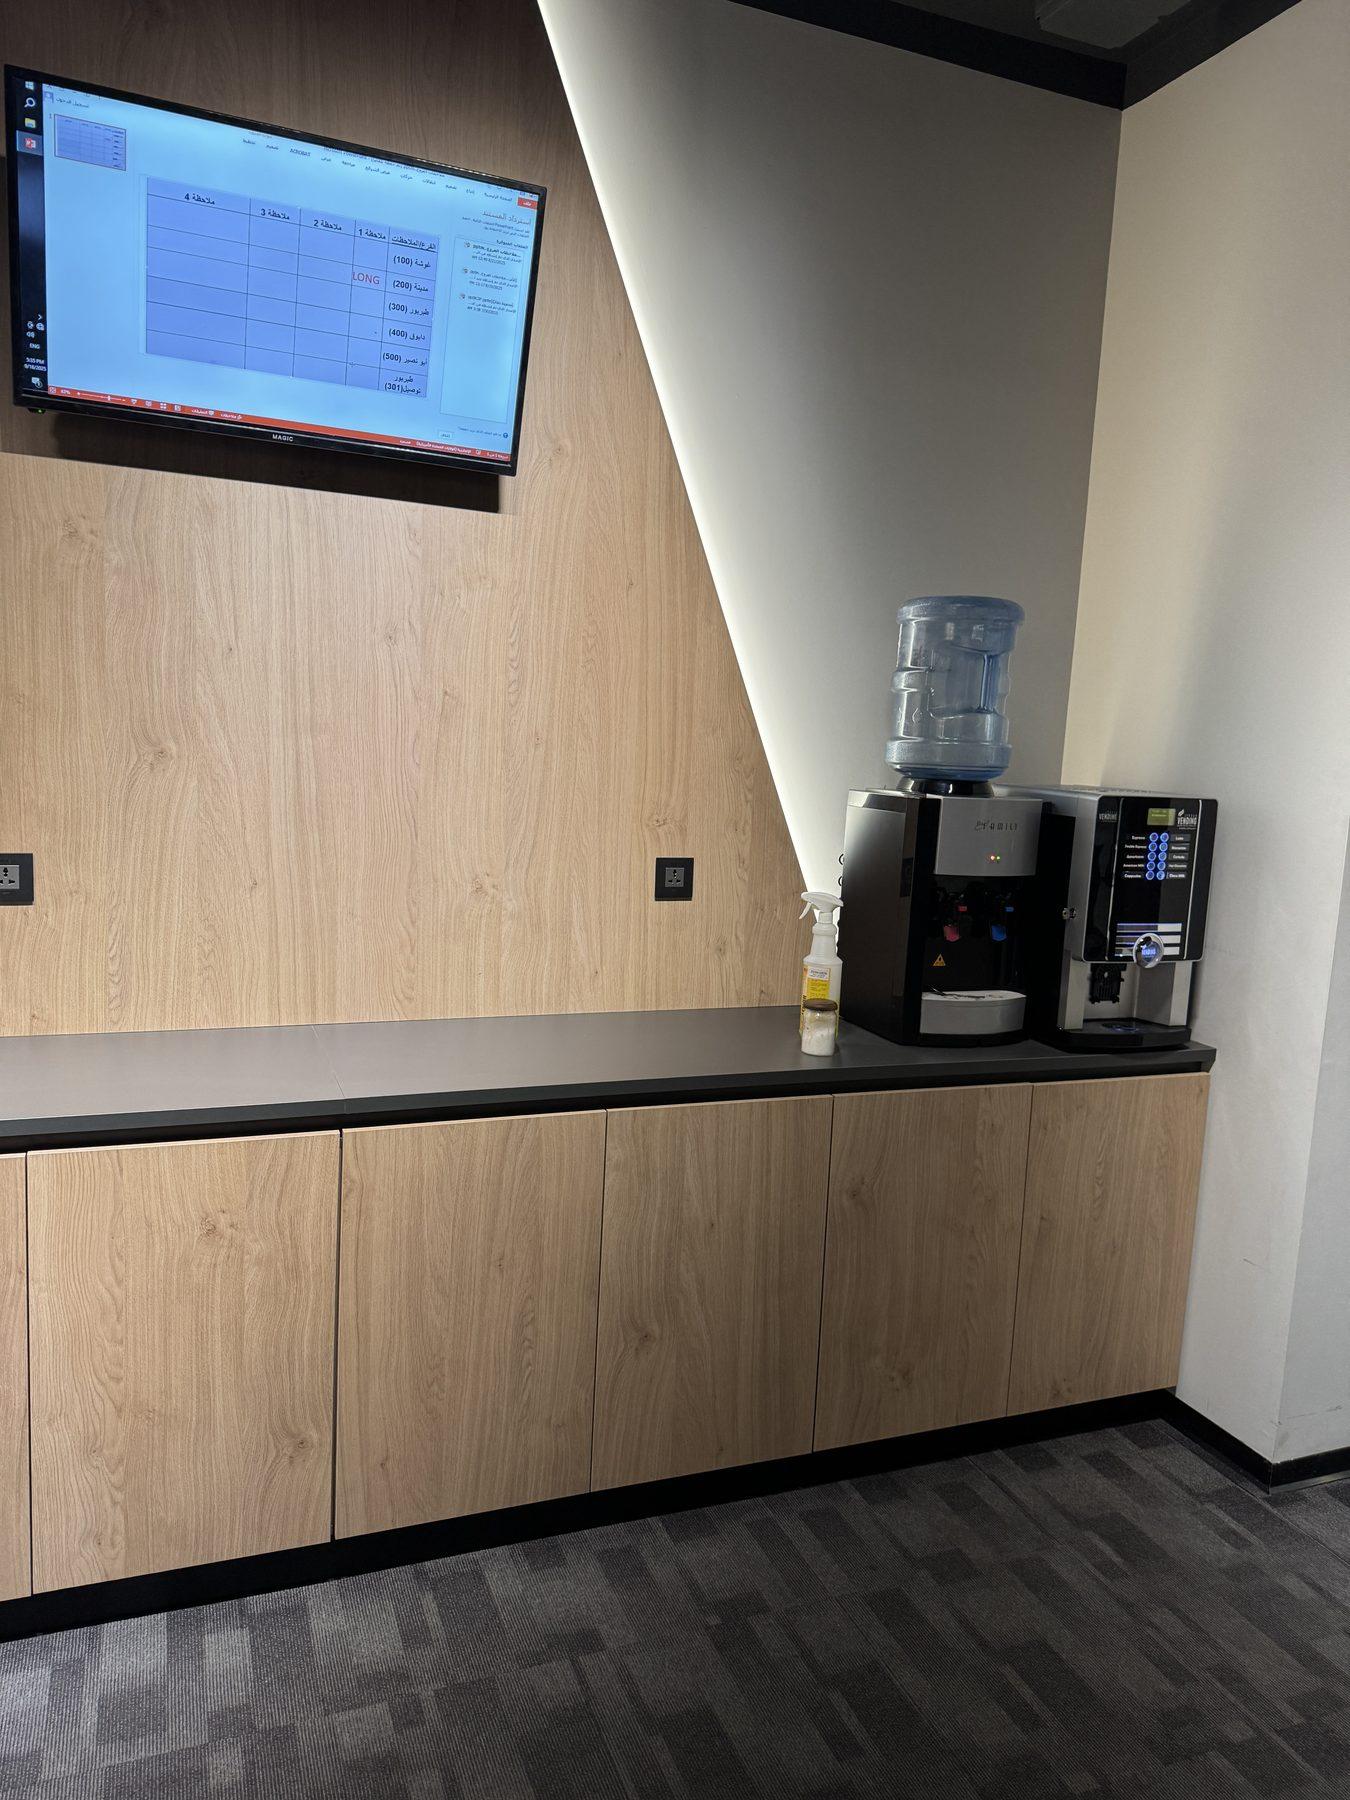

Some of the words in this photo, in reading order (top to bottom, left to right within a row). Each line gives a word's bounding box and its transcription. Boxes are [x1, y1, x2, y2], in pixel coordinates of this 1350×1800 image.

[192, 193, 215, 205] ملاحظة
[260, 208, 266, 216] 3
[267, 208, 290, 220] ملاحظة
[313, 219, 319, 227] 2
[320, 220, 342, 231] ملاحظة
[358, 228, 363, 236] 1
[364, 228, 386, 240] ملاحظة
[393, 255, 413, 267] (100)
[352, 271, 380, 285] LONG
[392, 280, 412, 291] (200)
[388, 302, 408, 314] (300)
[388, 328, 408, 339] (400)
[382, 352, 402, 363] (500)
[272, 433, 294, 442] MAGIC
[1177, 816, 1198, 825] VENDING
